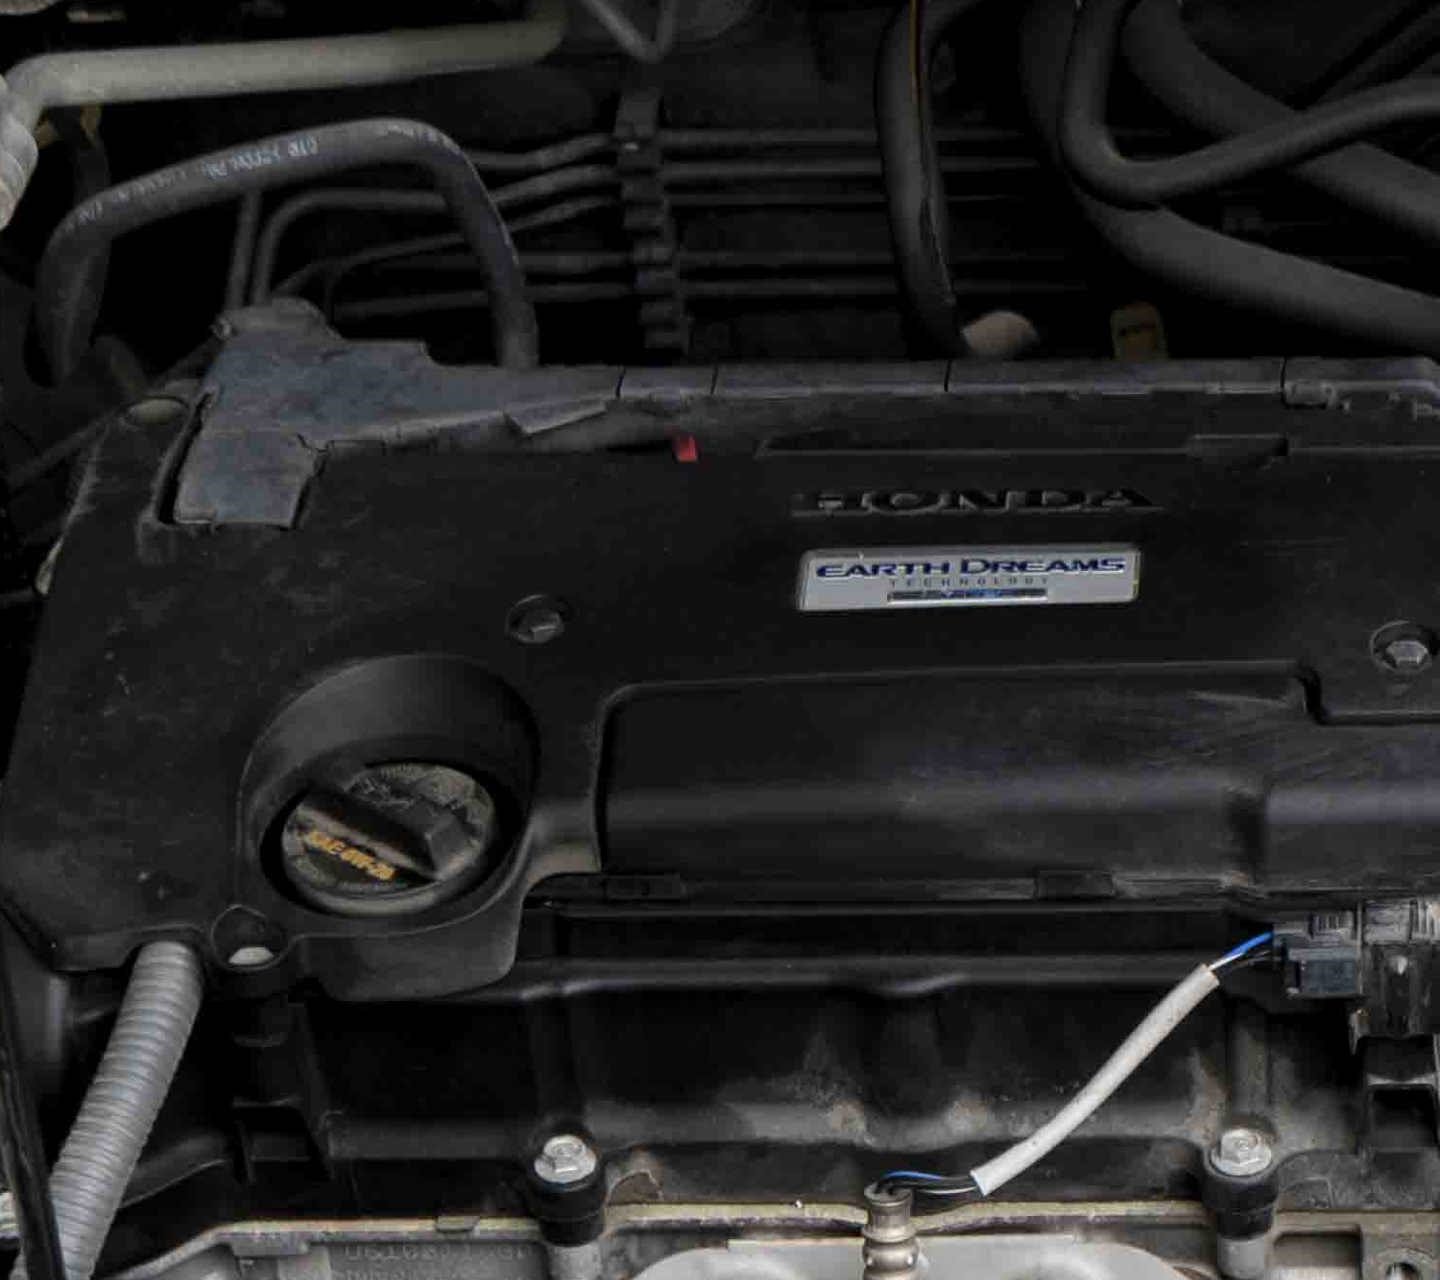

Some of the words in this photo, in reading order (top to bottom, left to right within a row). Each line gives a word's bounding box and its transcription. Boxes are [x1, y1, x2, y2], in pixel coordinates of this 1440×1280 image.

[791, 488, 1166, 518] HONDA
[816, 561, 950, 578] EARTH
[960, 557, 1126, 575] DREAMS
